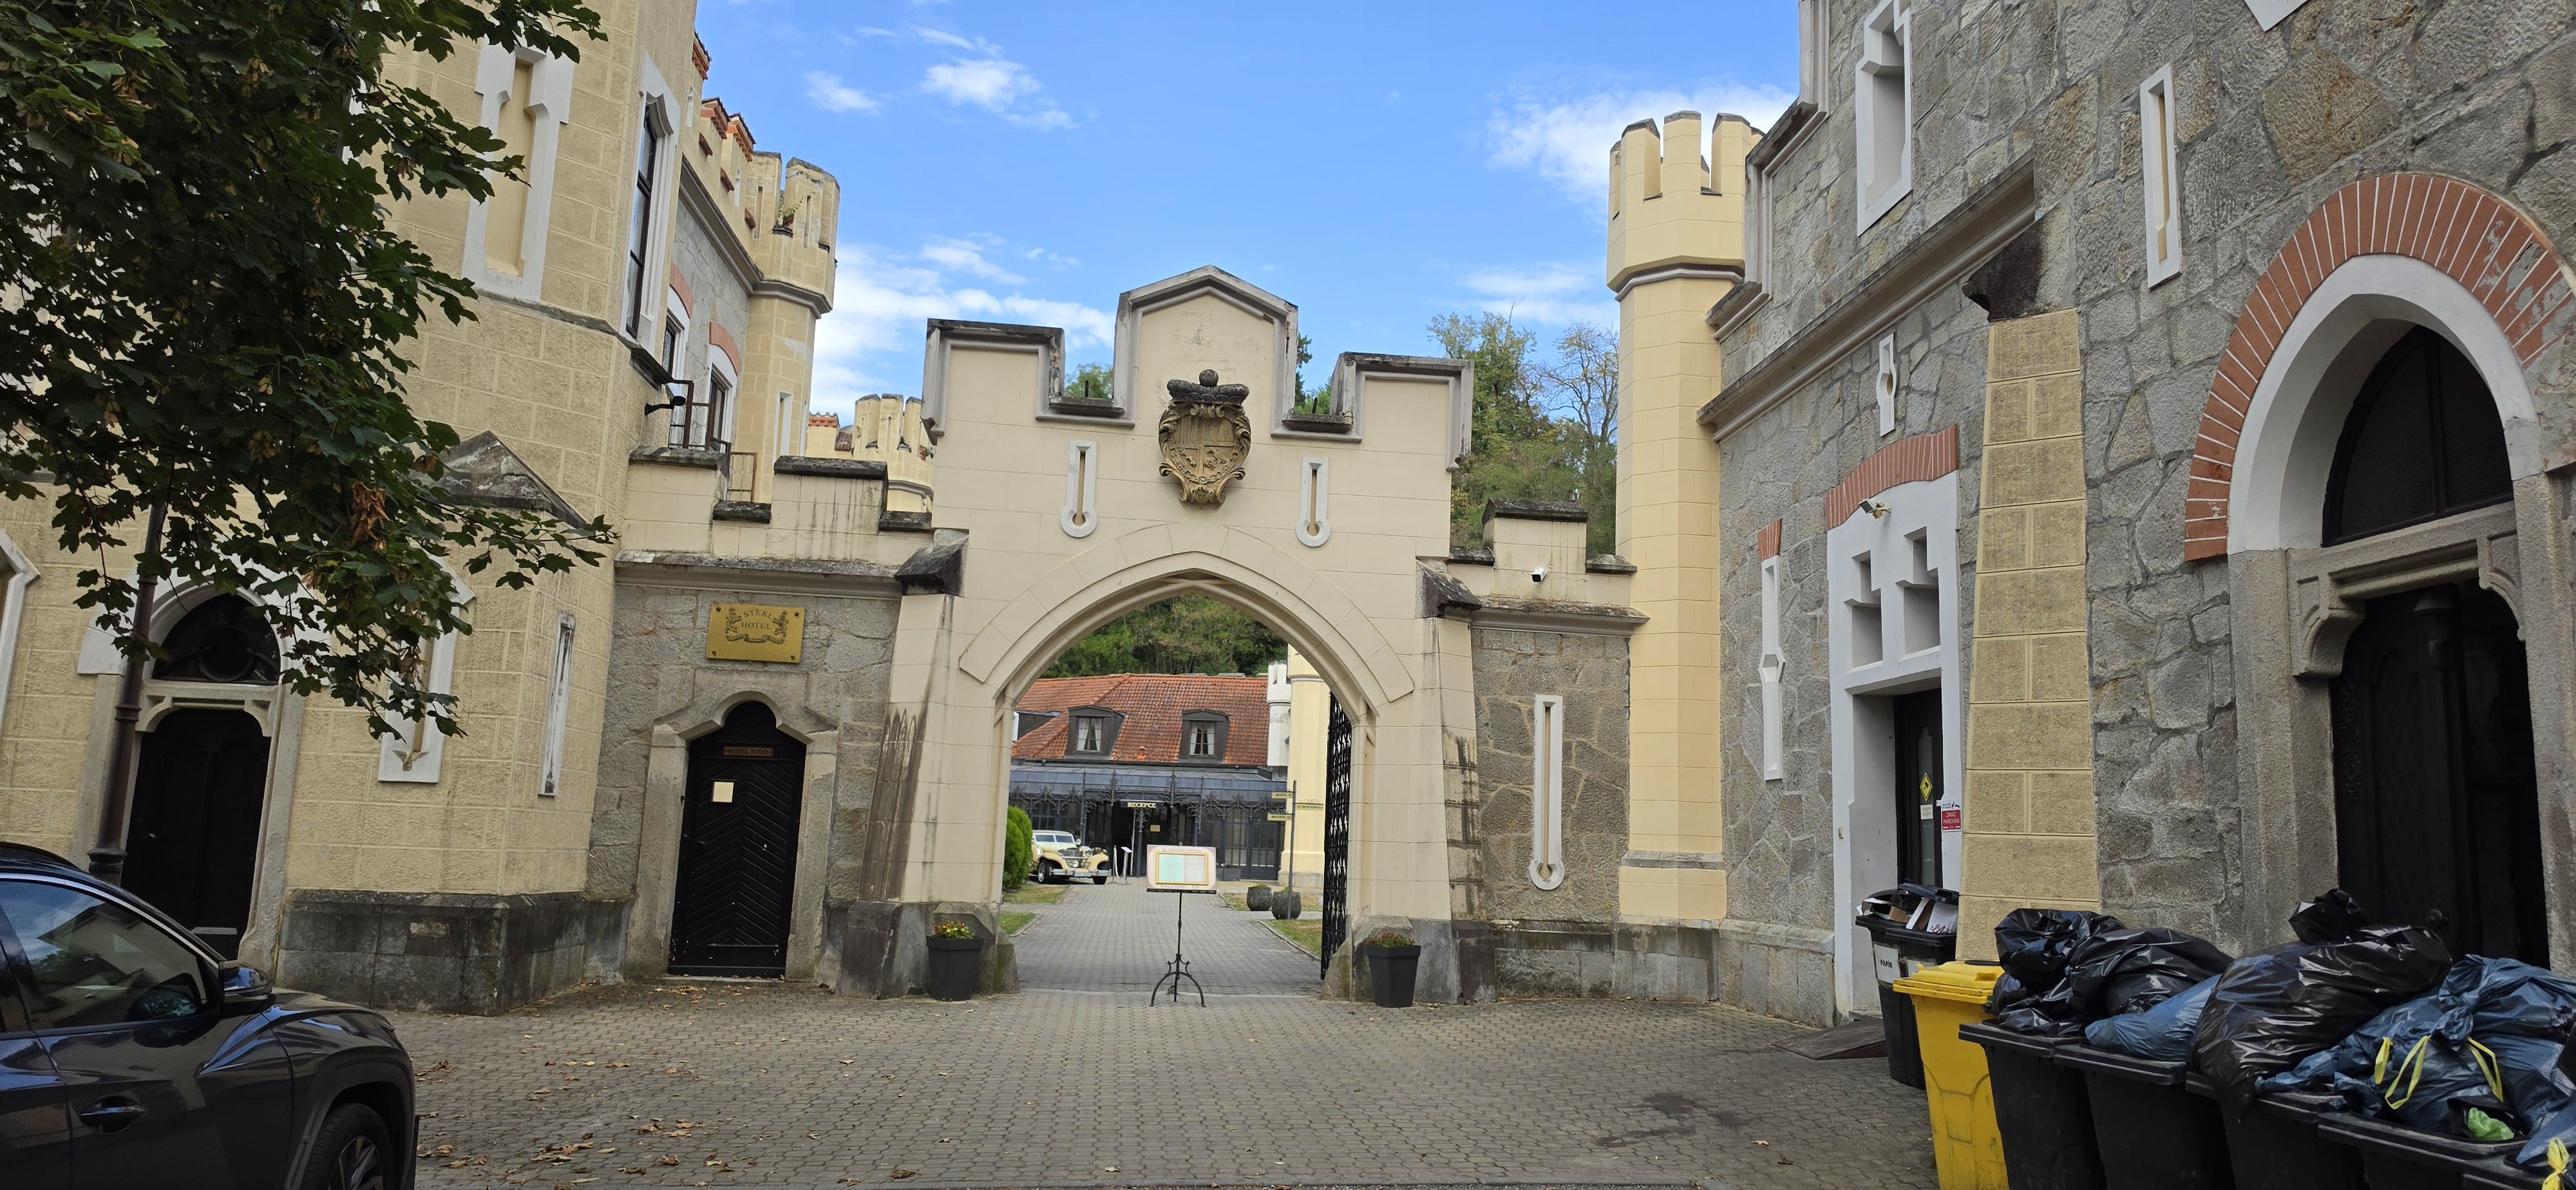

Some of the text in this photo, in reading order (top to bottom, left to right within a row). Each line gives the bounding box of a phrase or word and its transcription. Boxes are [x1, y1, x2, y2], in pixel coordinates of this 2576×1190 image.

[743, 609, 773, 620] STEKL
[741, 621, 772, 630] HOTEL
[1880, 959, 1893, 968] PAPÍR
